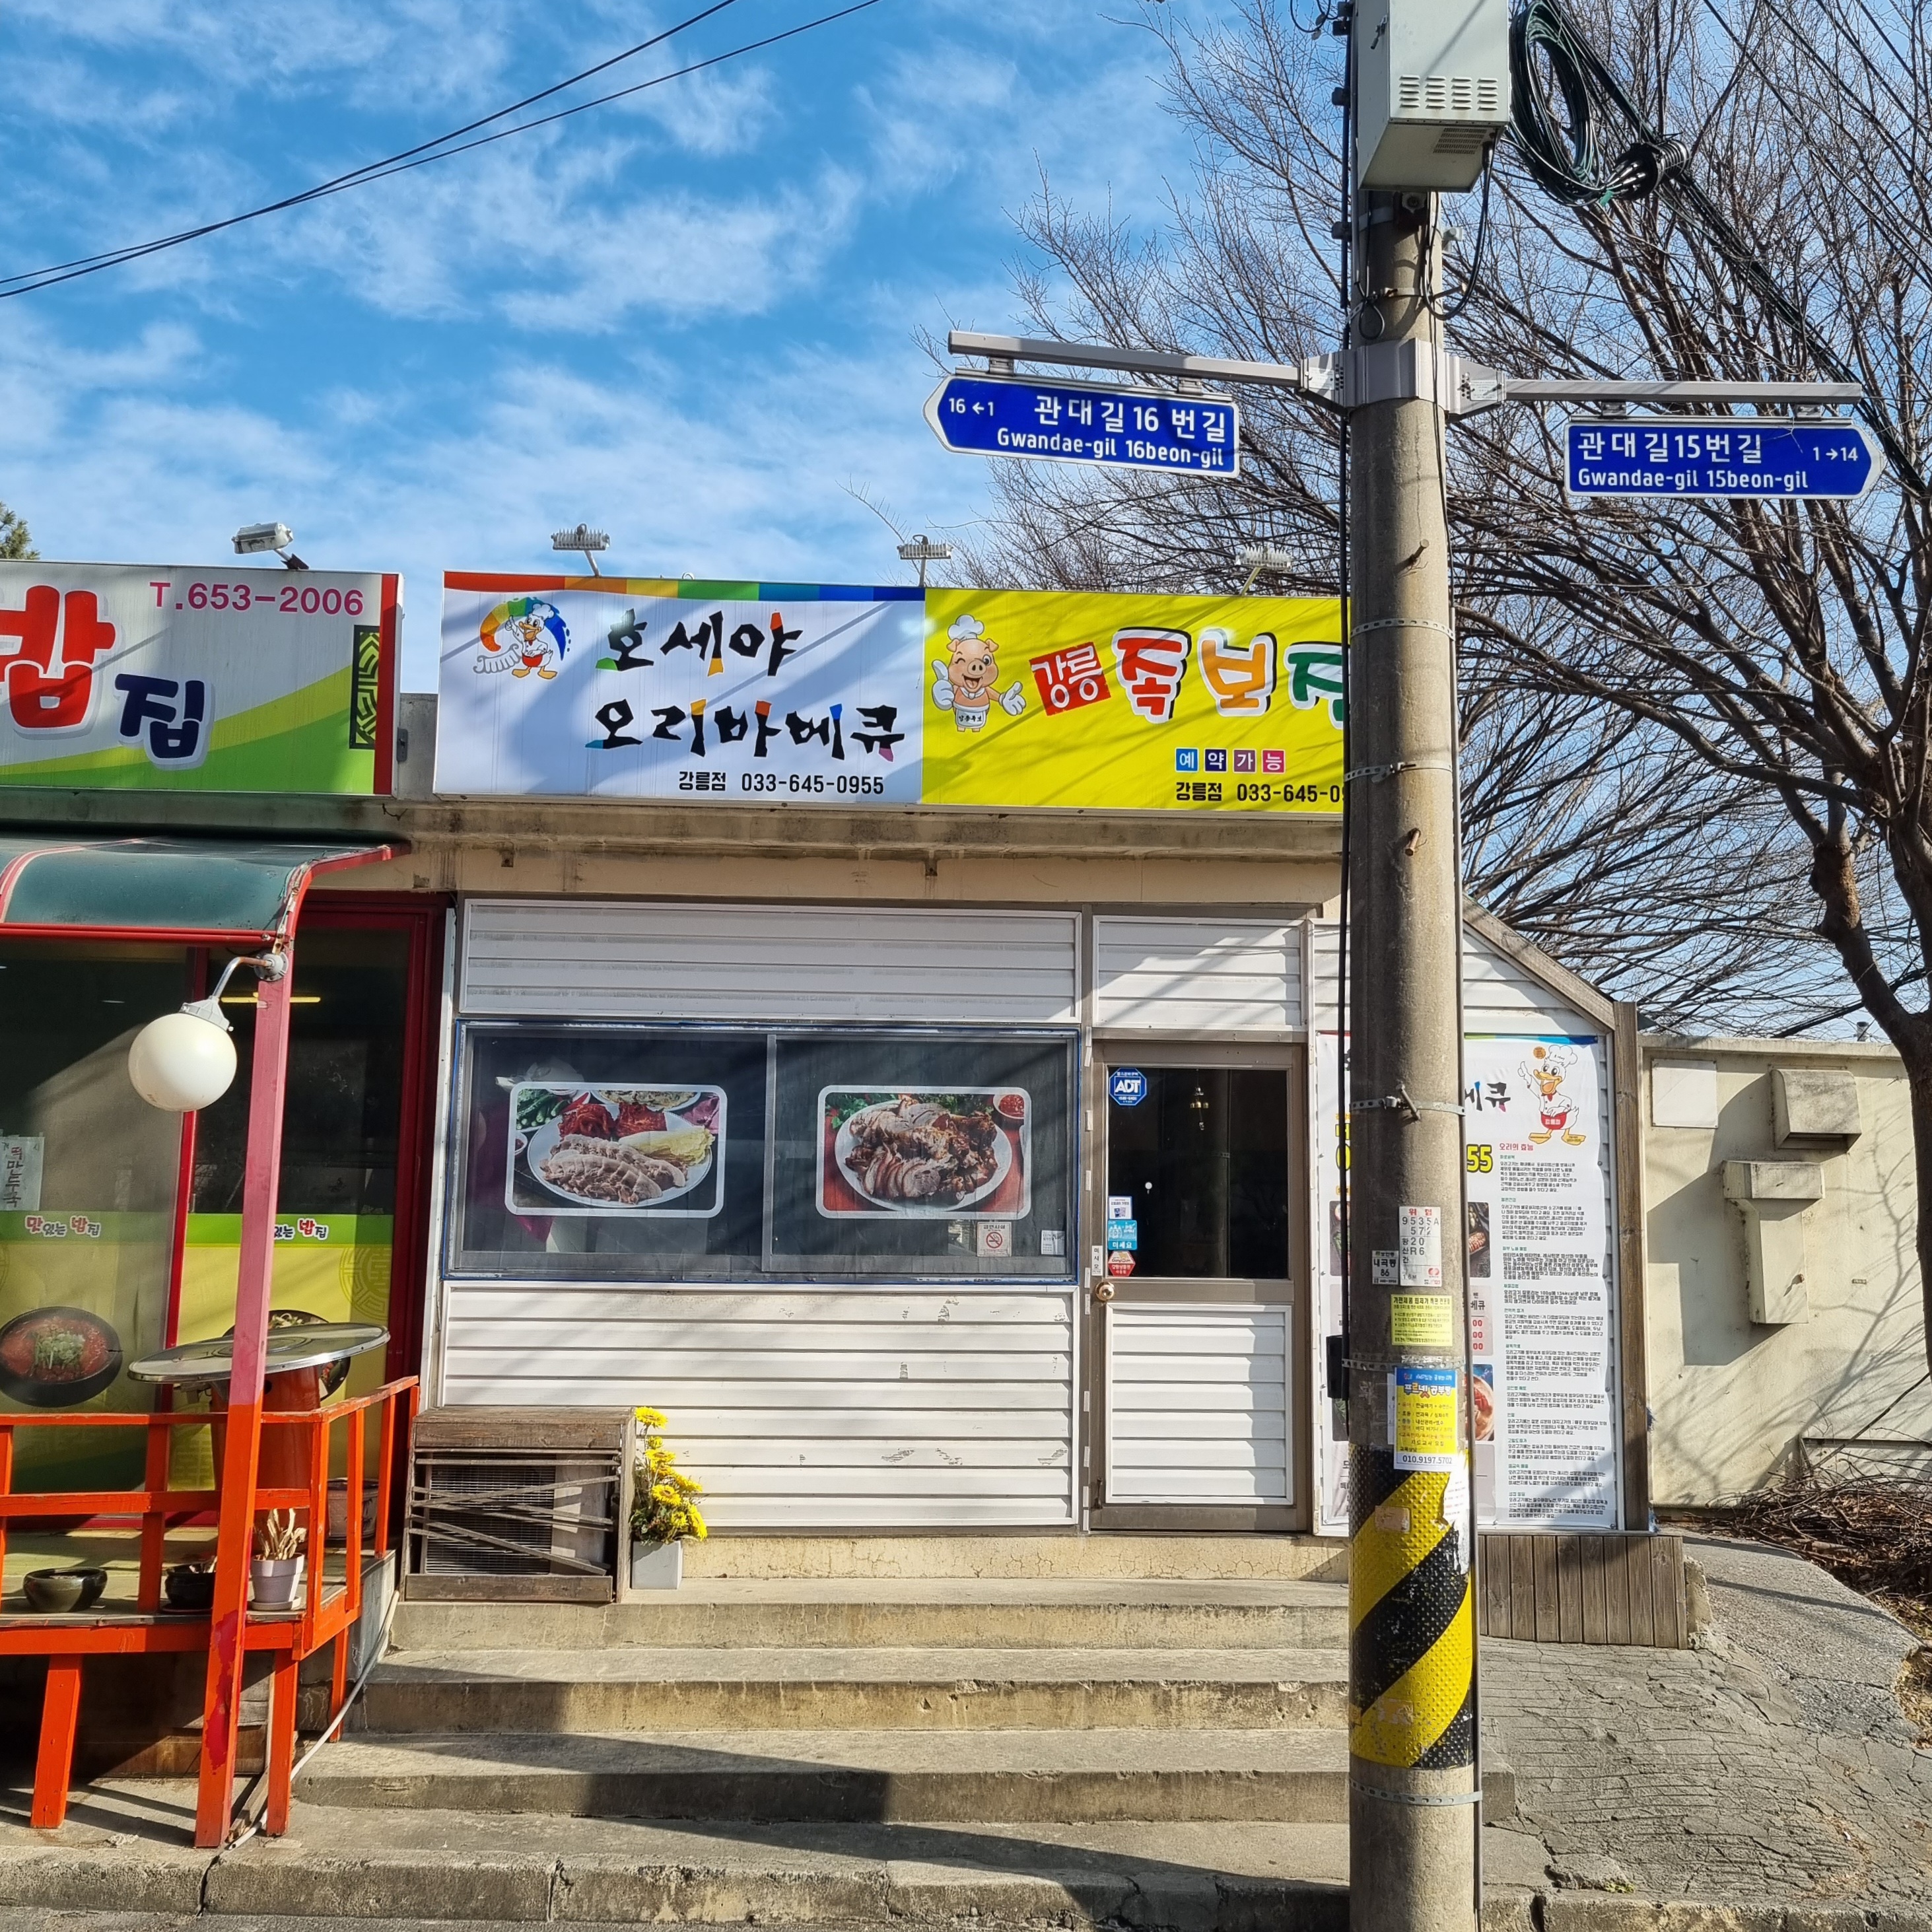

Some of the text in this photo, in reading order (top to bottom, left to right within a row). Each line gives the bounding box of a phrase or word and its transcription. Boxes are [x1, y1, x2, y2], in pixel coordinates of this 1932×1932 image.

[949, 397, 994, 417] 16 1
[998, 427, 1223, 467] Gwandae-gil 16beon-gil
[1813, 448, 1858, 461] 1 14
[1578, 467, 1808, 491] Gwandae-gil 15beon-gil
[150, 582, 364, 615] T.653-2006
[596, 608, 802, 677] 호세야
[1032, 645, 1103, 708] 강릉
[585, 699, 905, 762] 오리바베큐
[679, 771, 883, 794] 강릉점 033-645-0955
[1176, 782, 1222, 801] 강릉점
[1115, 1080, 1141, 1093] ADT
[26, 1216, 99, 1236] 맛있는 밥집
[299, 1220, 327, 1238] 밥집
[1404, 1382, 1451, 1398] 푸르넷 공부방
